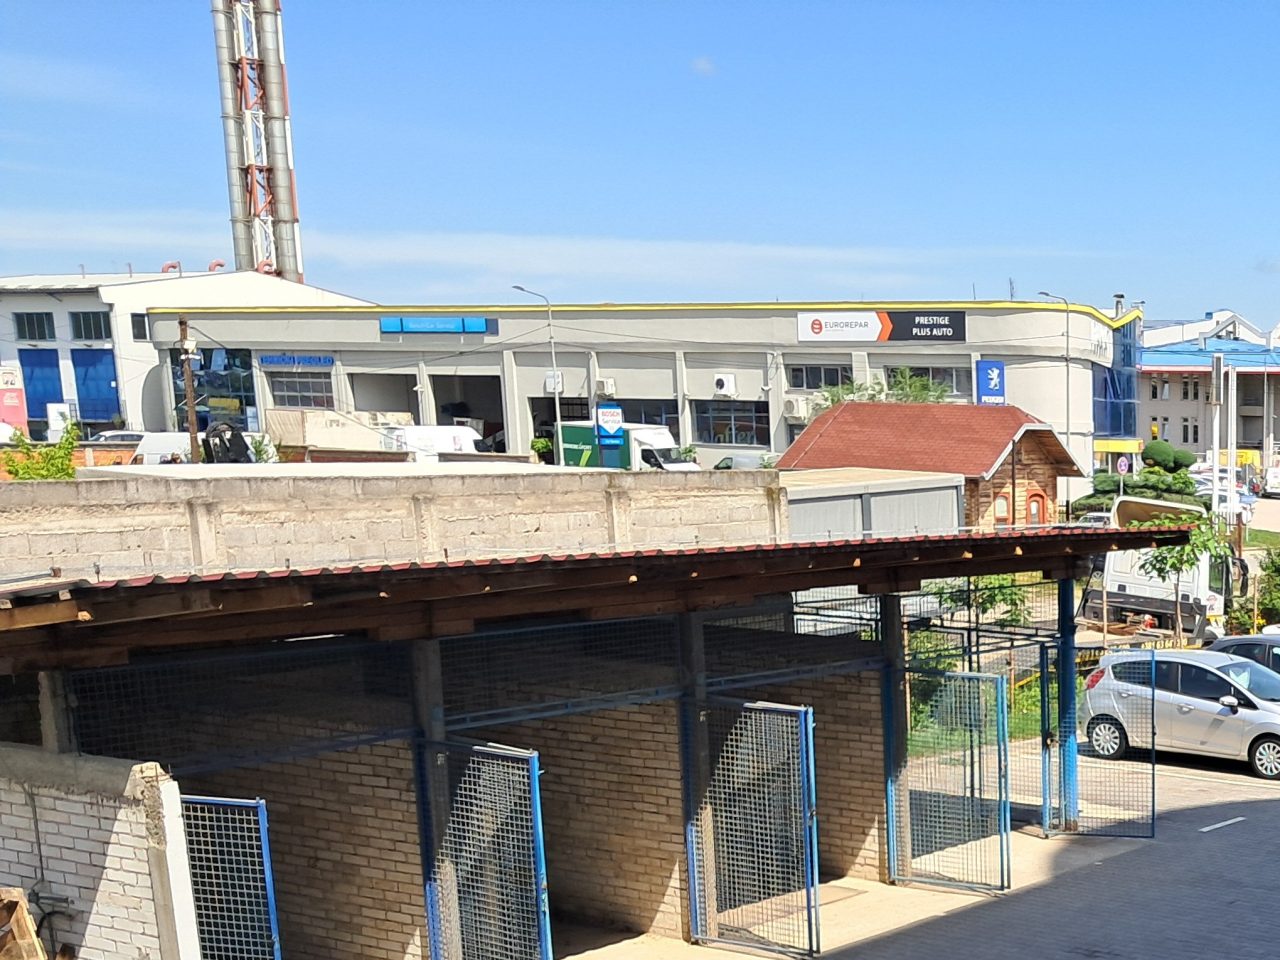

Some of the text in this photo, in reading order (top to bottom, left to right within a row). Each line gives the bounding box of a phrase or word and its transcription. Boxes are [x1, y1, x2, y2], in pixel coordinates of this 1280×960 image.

[824, 321, 869, 329] EUROREPAR
[915, 316, 950, 325] PRESTIGE
[912, 327, 953, 336] PLUS AUTO
